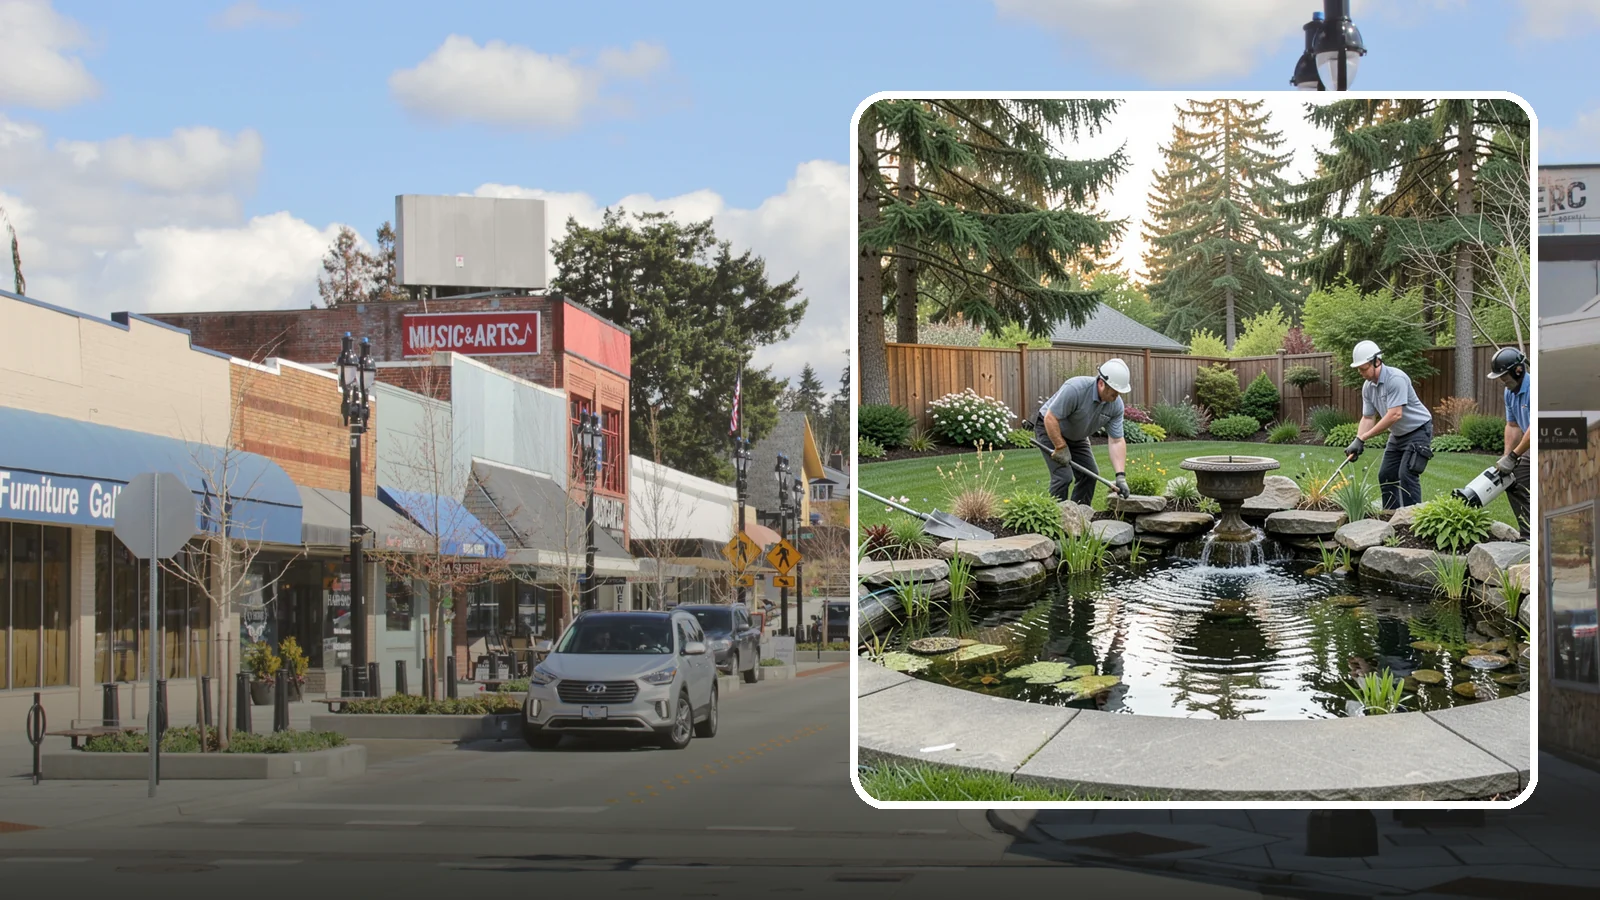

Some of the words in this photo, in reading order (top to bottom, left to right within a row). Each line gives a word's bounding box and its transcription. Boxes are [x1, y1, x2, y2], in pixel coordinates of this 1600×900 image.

[409, 323, 519, 349] MUSIC&ARTS
[1540, 427, 1578, 437] UGA
[0, 471, 79, 516] Furniture
[453, 563, 479, 574] SUSHI
